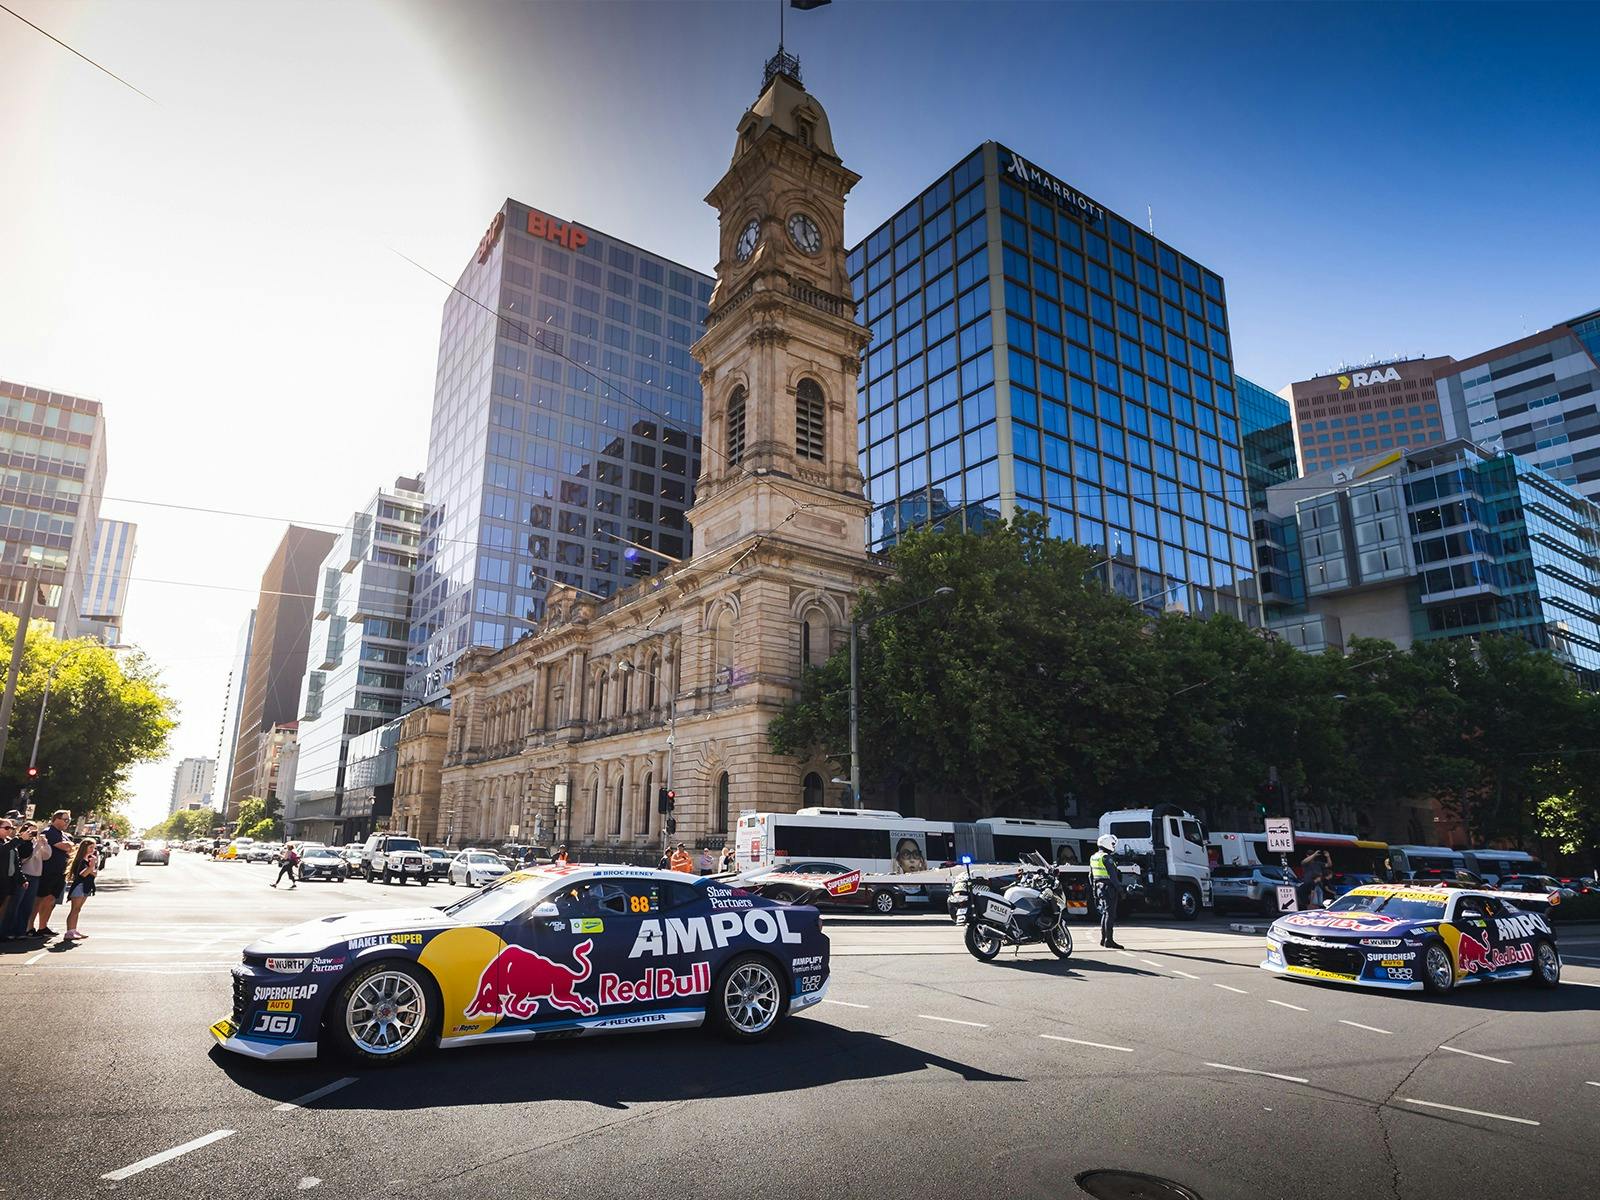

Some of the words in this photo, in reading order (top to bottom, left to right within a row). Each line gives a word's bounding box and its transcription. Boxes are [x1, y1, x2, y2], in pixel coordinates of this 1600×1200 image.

[1031, 168, 1105, 220] MARRIOTT
[527, 209, 590, 252] BHP
[1352, 367, 1402, 388] RAA
[1331, 465, 1356, 485] EY
[1269, 839, 1291, 848] LANE
[827, 873, 859, 890] SUPERCHEAP
[706, 886, 732, 897] Shaw
[630, 896, 650, 913] 88
[711, 898, 754, 908] Partners
[990, 903, 1008, 915] POLICE
[628, 909, 802, 958] AMPOL
[348, 936, 378, 950] MAKE
[379, 935, 389, 945] IT
[391, 934, 423, 945] SUPER
[313, 957, 333, 965] Shaw
[796, 956, 823, 966] AMPLIFY
[1367, 952, 1416, 961] SUPERCHEAP
[1492, 948, 1510, 968] Red
[1507, 942, 1535, 963] Bull
[274, 960, 305, 969] WÜRTH
[311, 964, 344, 972] Partners
[599, 973, 655, 1006] Red
[656, 962, 711, 999] Bull
[801, 982, 820, 992] LOCK
[253, 984, 319, 1001] SUPERCHEAP
[269, 1001, 290, 1009] AUTO
[253, 1016, 297, 1034] JGI
[608, 1014, 667, 1026] FREIGHTER
